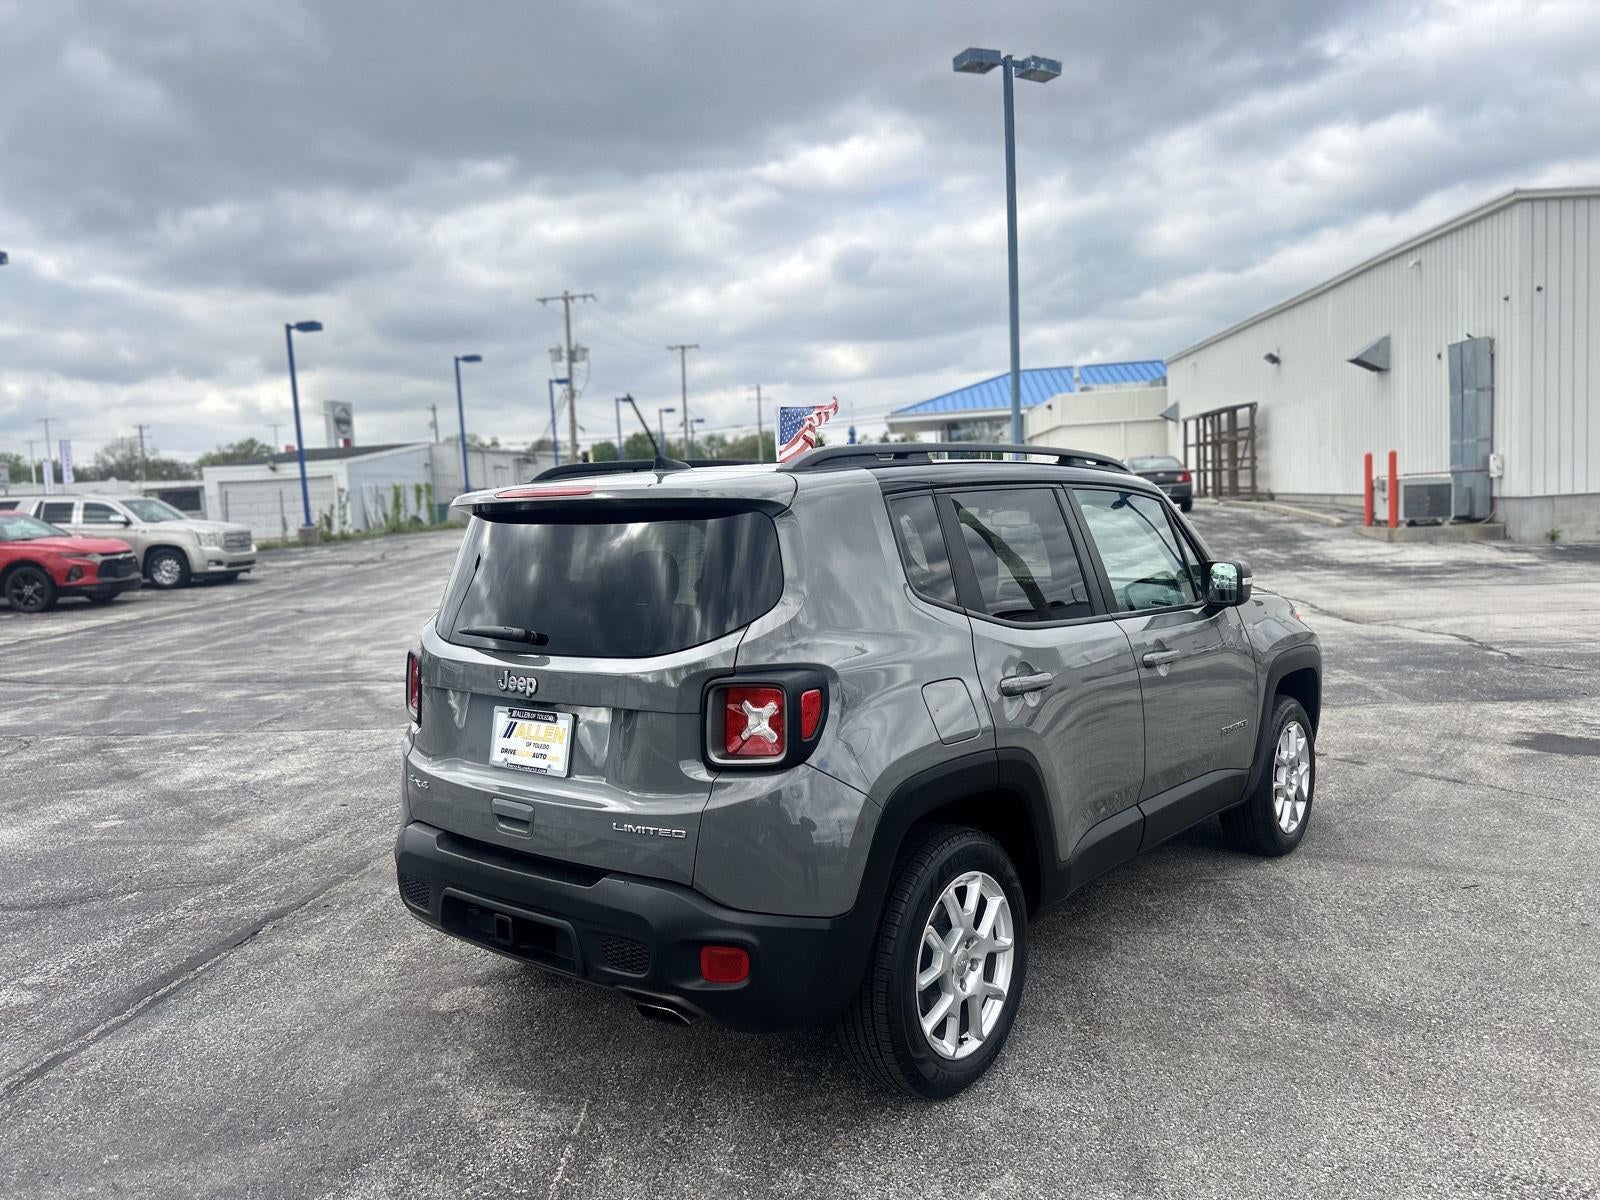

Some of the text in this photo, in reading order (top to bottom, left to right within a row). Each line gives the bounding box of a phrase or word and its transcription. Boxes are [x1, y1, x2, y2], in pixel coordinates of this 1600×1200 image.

[498, 670, 538, 697] Jeep
[516, 710, 530, 718] ALLEN
[537, 713, 553, 721] TOLEDO
[515, 722, 566, 743] ALLEN
[612, 822, 687, 839] LIMITED
